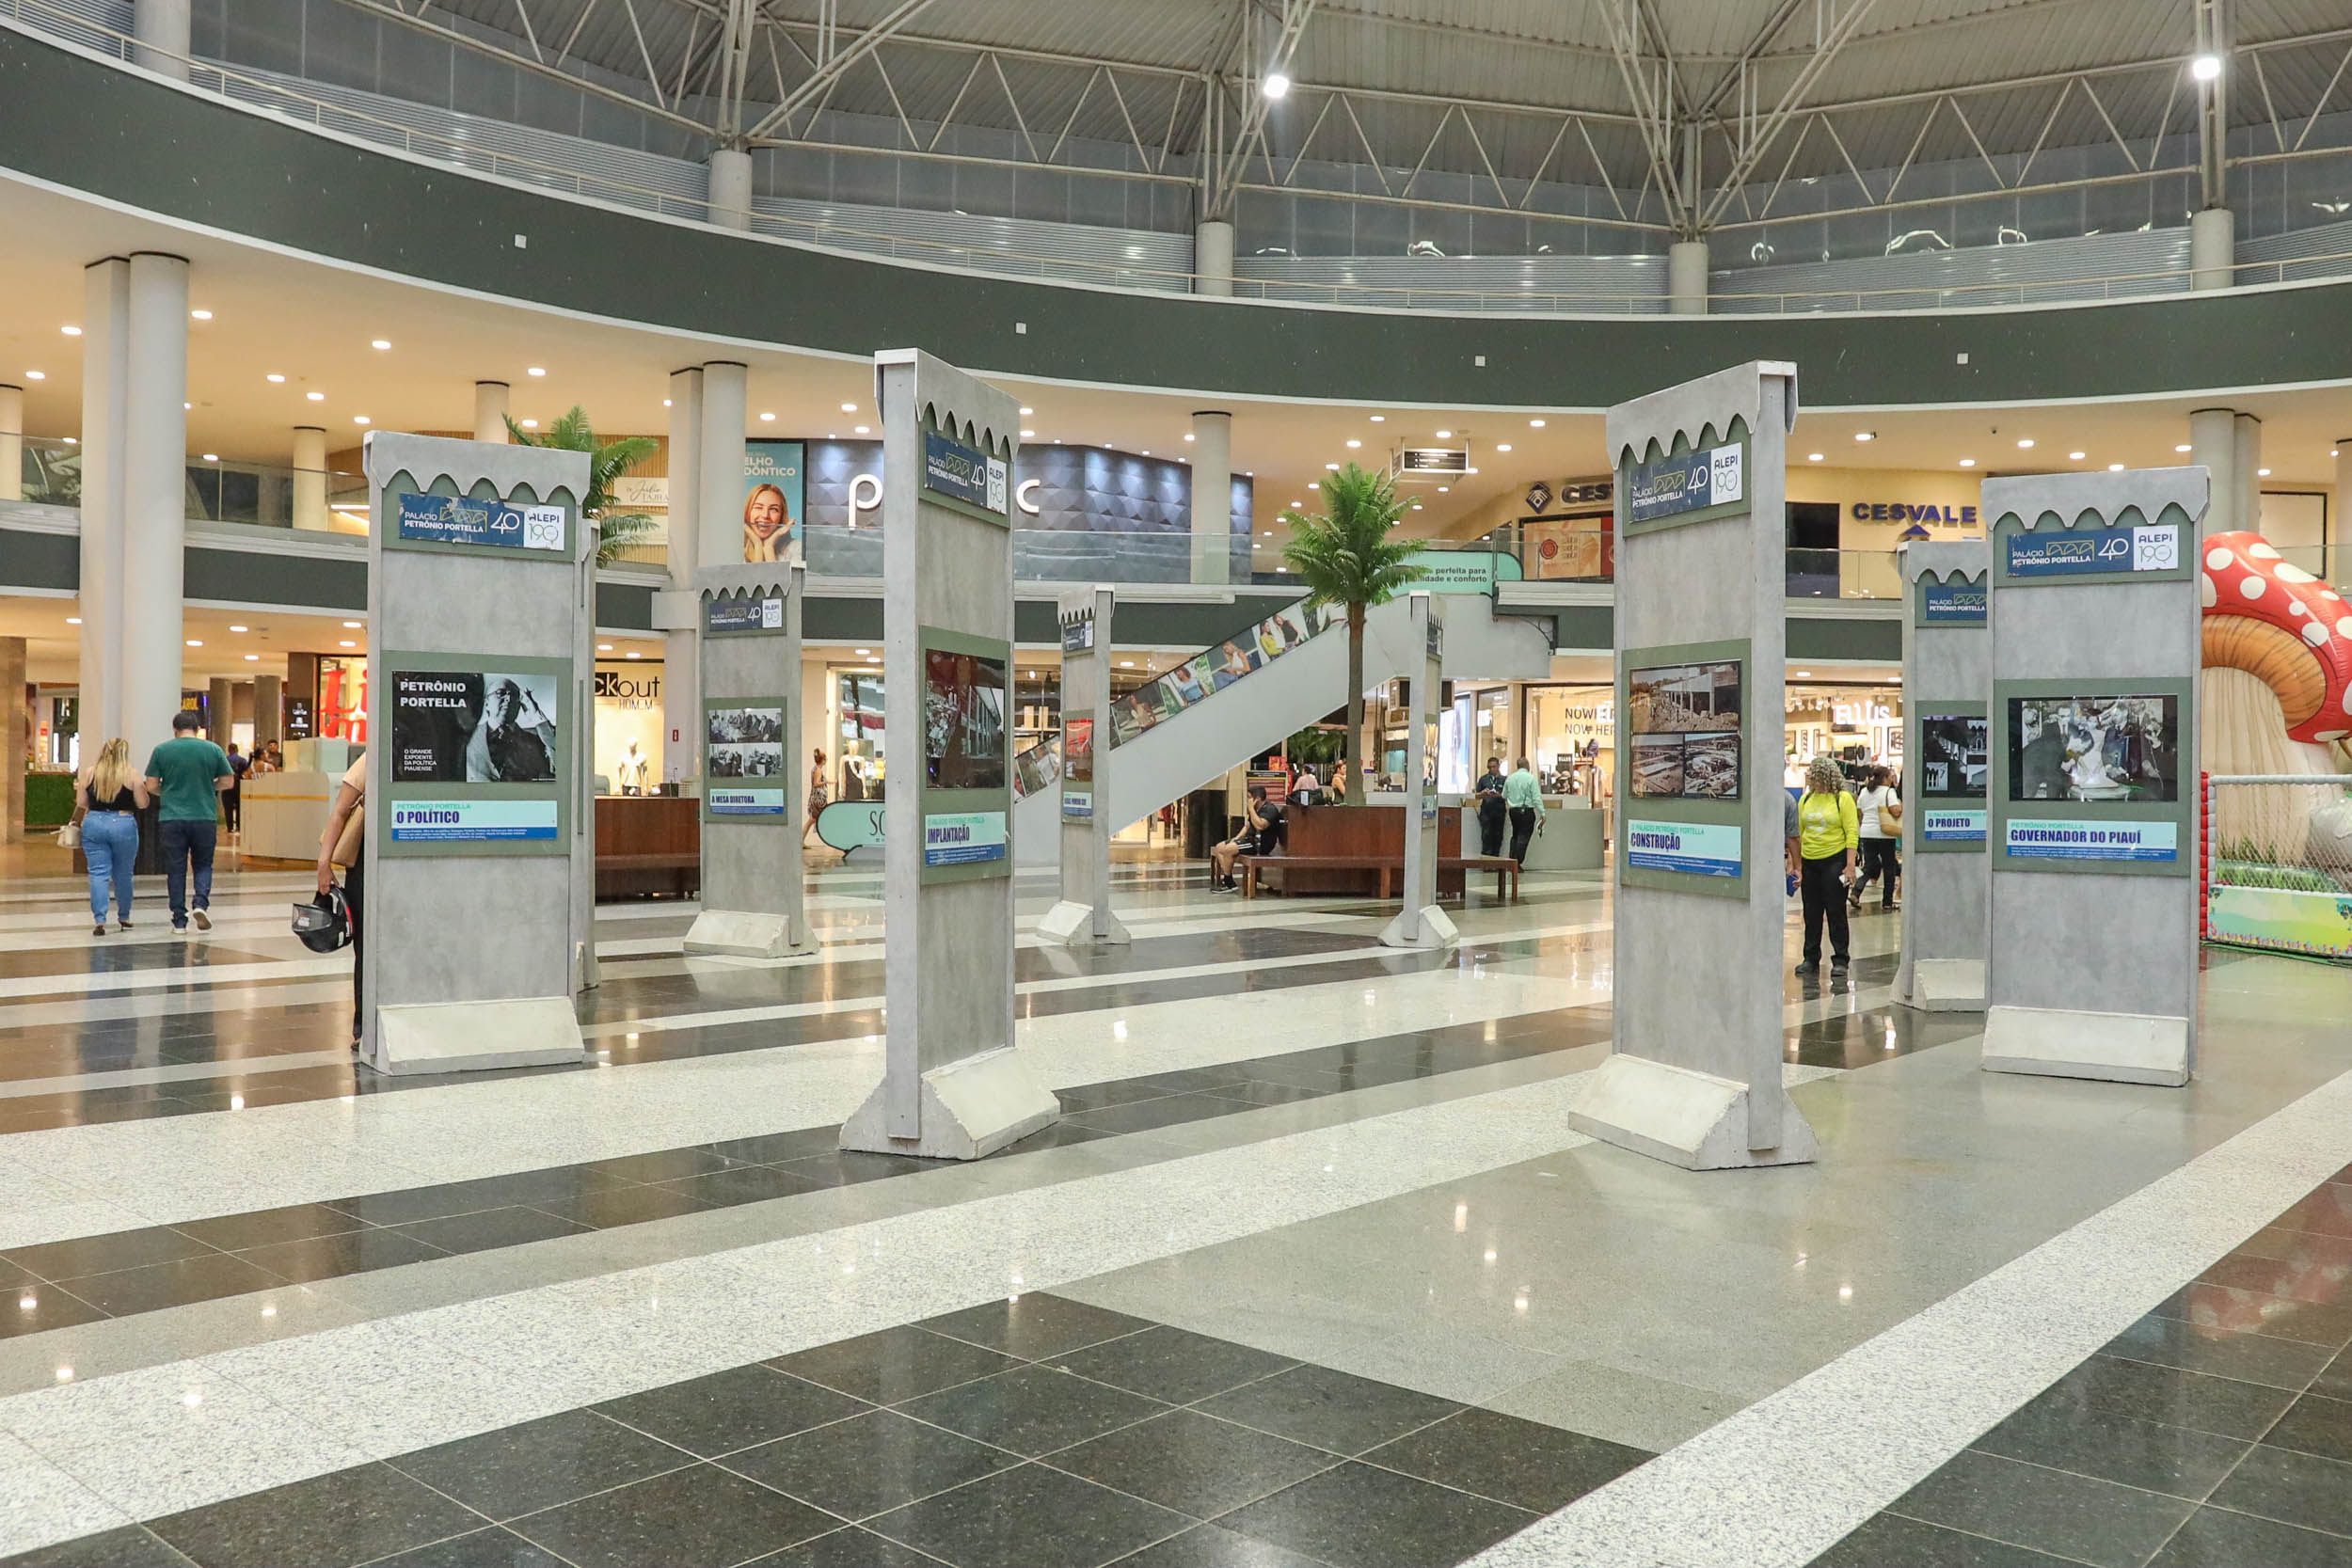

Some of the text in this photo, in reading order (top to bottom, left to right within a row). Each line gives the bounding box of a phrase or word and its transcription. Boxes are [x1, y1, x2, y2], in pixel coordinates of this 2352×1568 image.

[1714, 454, 1739, 469] ALEPI
[970, 464, 986, 491] 40
[989, 467, 1005, 482] ALEPI
[1687, 466, 1708, 495] 40
[1562, 483, 1613, 503] CES
[405, 512, 437, 521] PALÁCIO
[529, 513, 560, 523] ALEPI
[1852, 503, 1977, 523] CESVALE
[405, 519, 484, 533] PETRÔNIO PORTELLA
[490, 512, 520, 534] 40
[2138, 533, 2172, 544] ALEPI
[2012, 548, 2044, 558] PALÁCIO
[2097, 537, 2129, 561] 40
[2012, 555, 2091, 565] PETRÔNIO PORTELLA
[1436, 566, 1486, 576] perfeita para
[400, 679, 467, 693] PETRÔNIO
[400, 697, 468, 708] PORTELLA
[396, 808, 460, 824] O POLÍTICO
[1928, 818, 1971, 828] O PROJETO
[928, 824, 970, 845] IMPLANTAÇÃO
[1631, 832, 1680, 852] CONSTRUÇÃO
[2010, 829, 2141, 844] GOVERNADOR DO PIAUÍ
